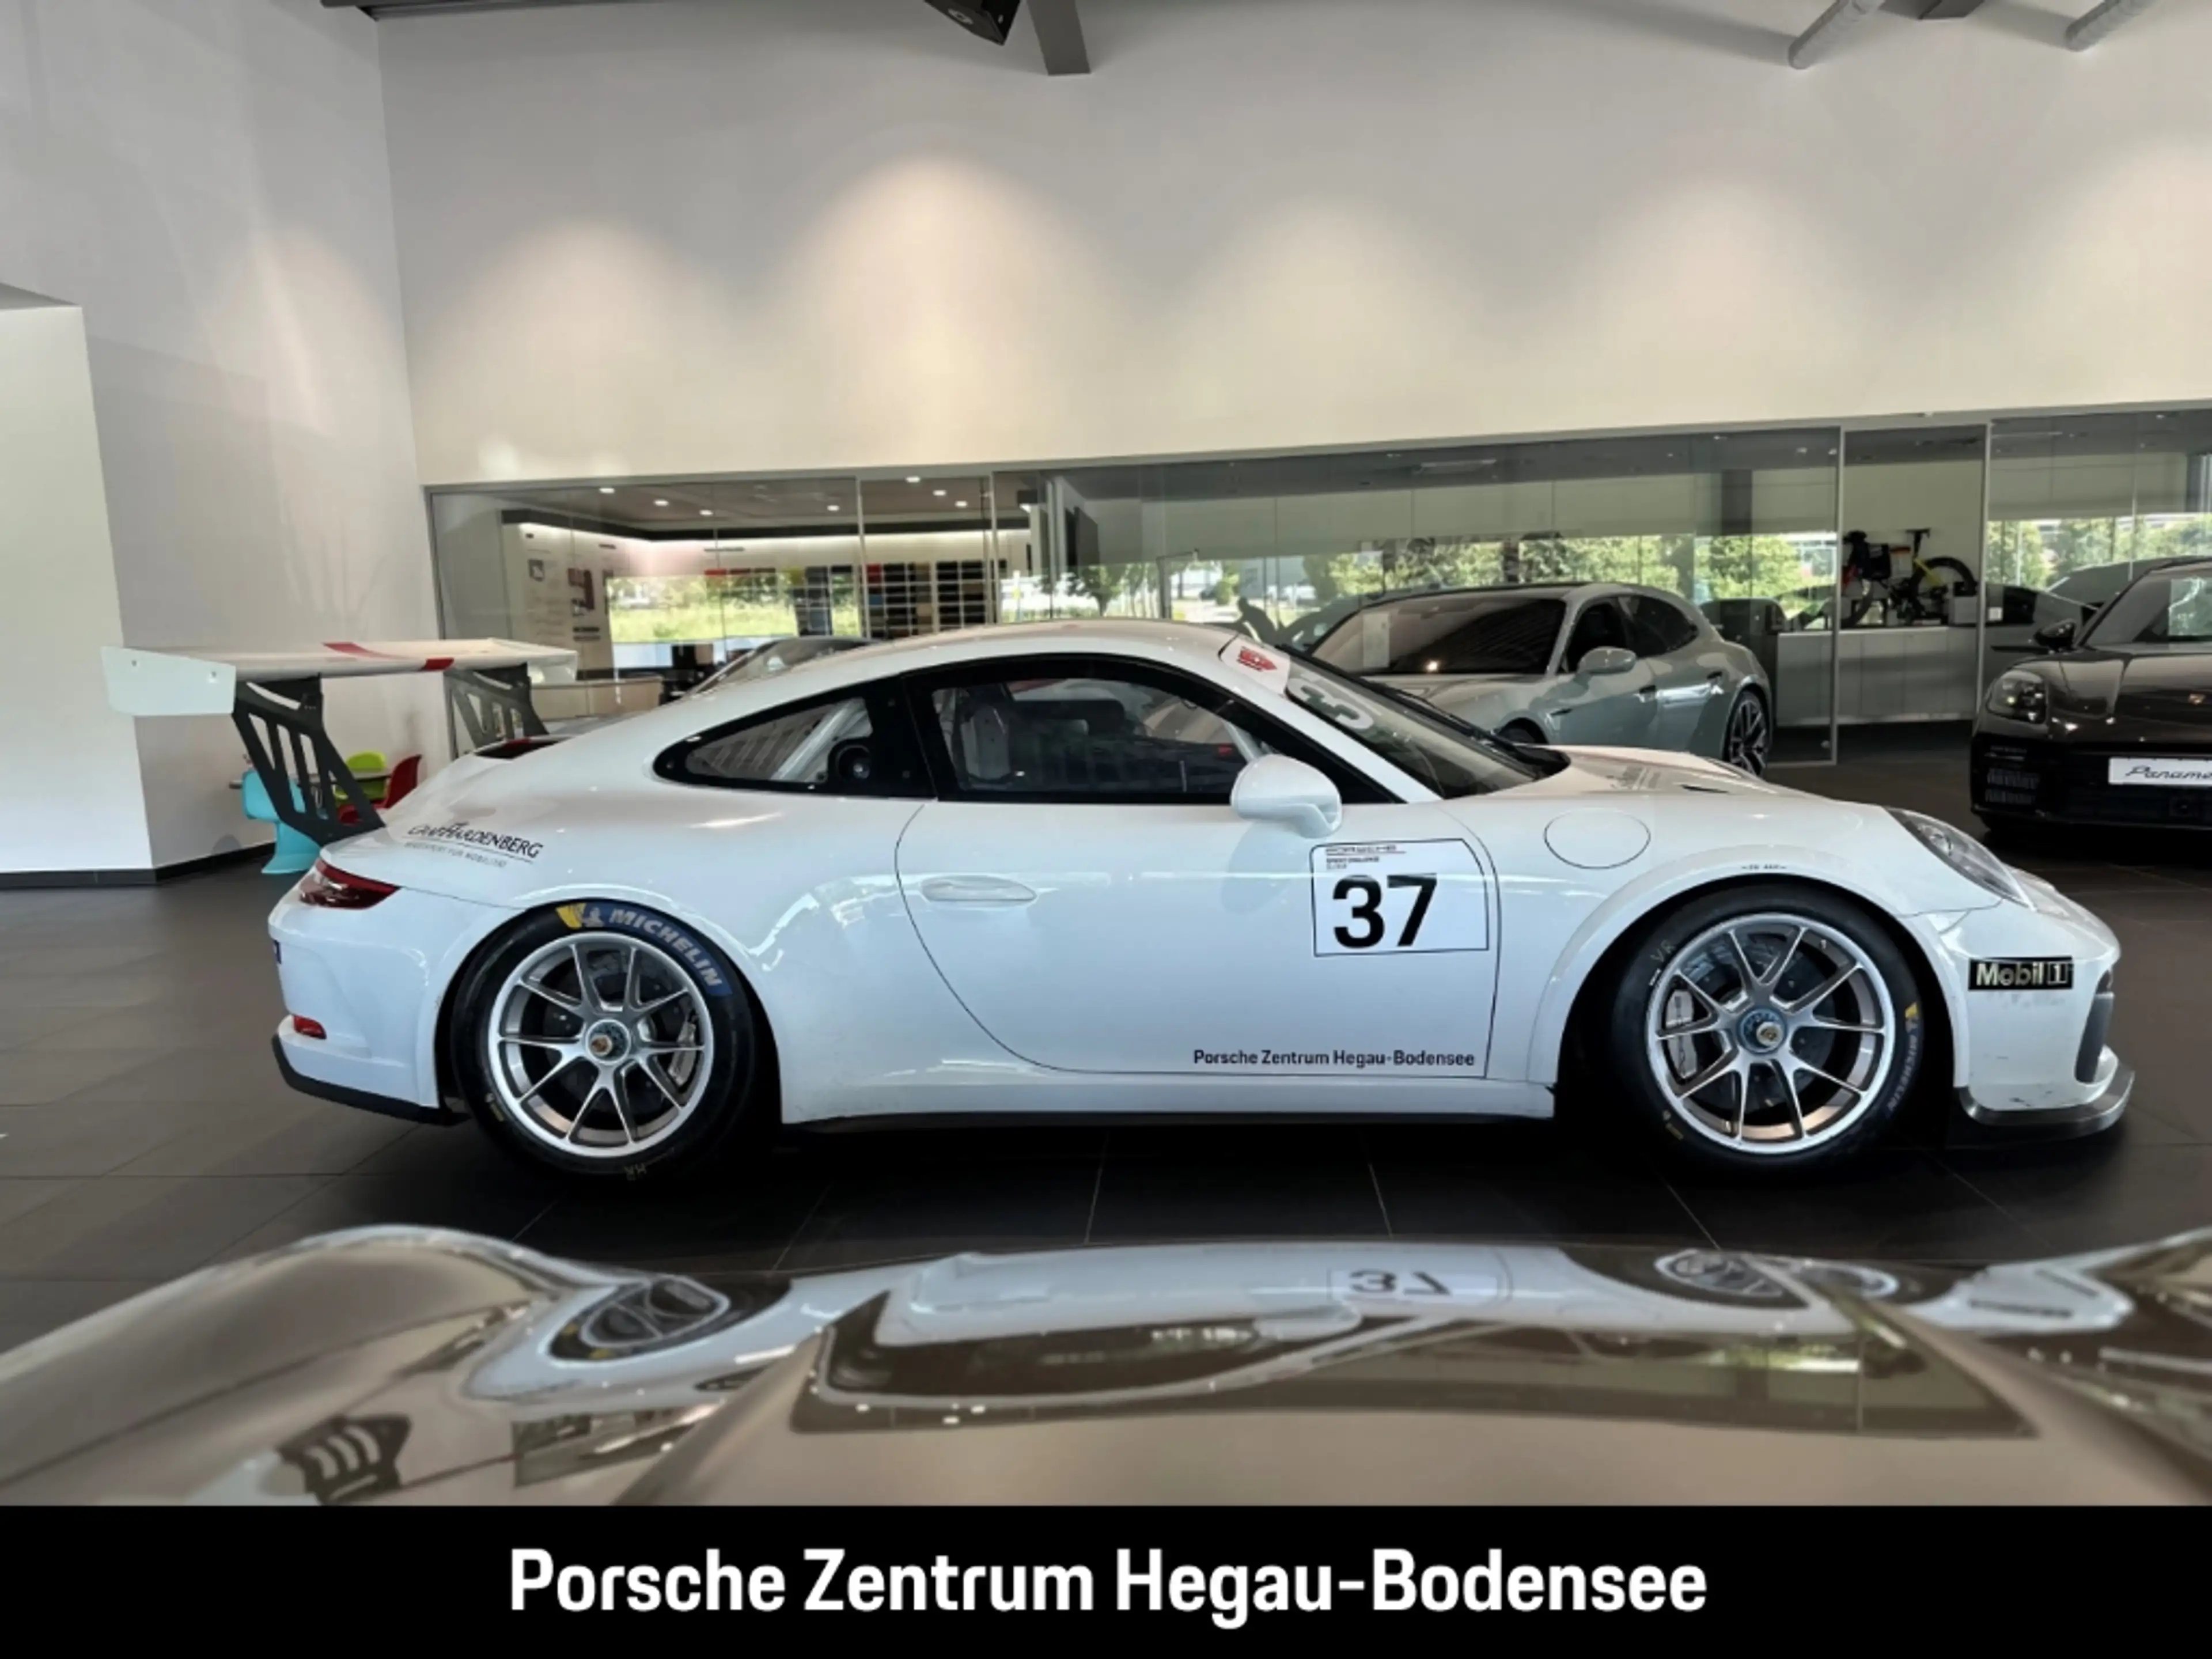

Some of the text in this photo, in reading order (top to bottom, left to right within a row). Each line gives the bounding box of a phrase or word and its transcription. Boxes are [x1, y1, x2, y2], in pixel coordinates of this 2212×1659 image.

[1332, 873, 1438, 948] 37
[608, 909, 722, 987] MICHELIN
[1976, 961, 2044, 986] Mobil
[1194, 1049, 1475, 1069] Porsche Zentrum Hegau-Bodensee
